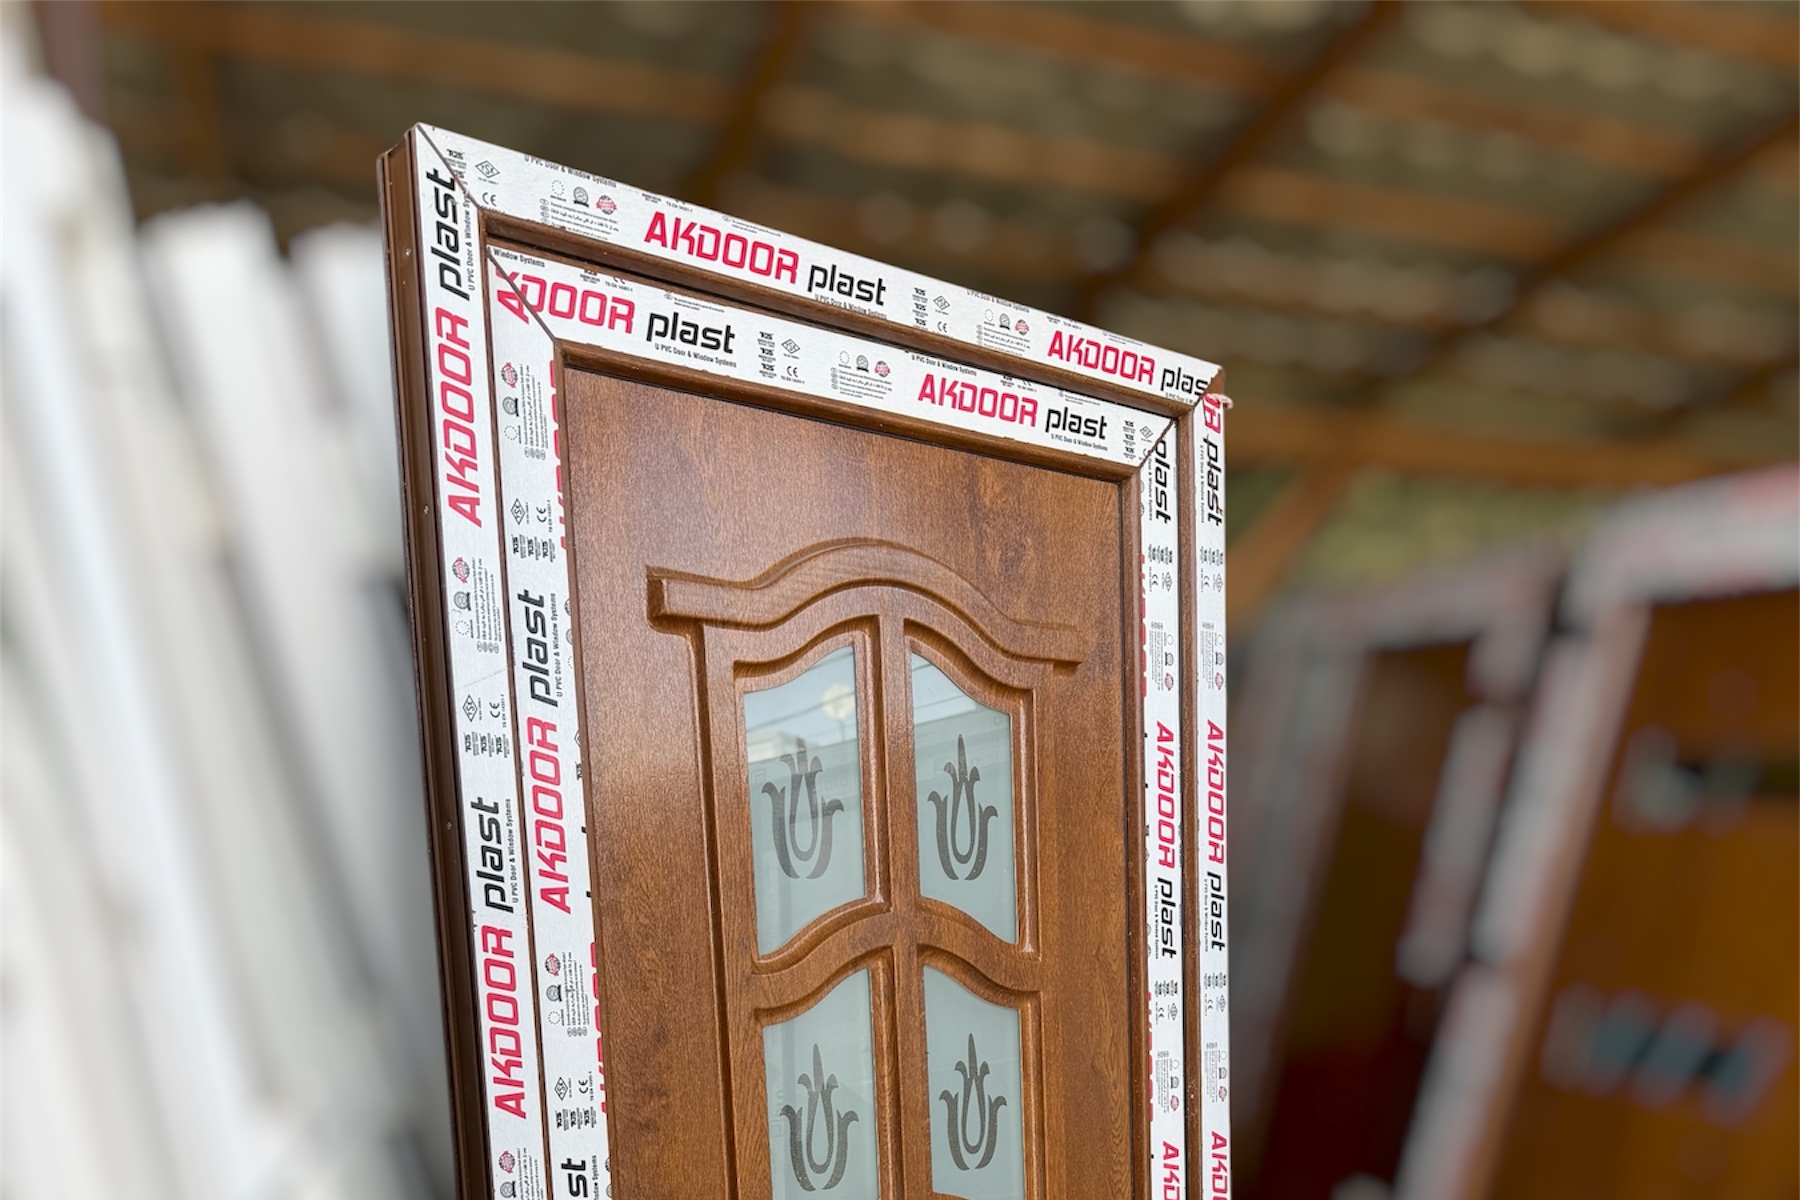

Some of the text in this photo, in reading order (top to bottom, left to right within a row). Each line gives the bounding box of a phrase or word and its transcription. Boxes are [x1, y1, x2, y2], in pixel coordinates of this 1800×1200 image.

[491, 248, 546, 269] Window Systems
[644, 211, 799, 285] AKDOOR
[808, 264, 886, 306] plast
[426, 168, 482, 528] AKDOOR plast
[646, 311, 735, 354] plast
[659, 344, 672, 352] PVC
[671, 346, 686, 356] Door
[691, 351, 714, 362] Window
[713, 356, 737, 369] Systems
[1047, 330, 1155, 386] AKDOOR
[1160, 367, 1208, 396] plas
[917, 373, 1038, 428] AKDOOR
[1045, 406, 1108, 440] plast
[1203, 433, 1223, 527] plast
[549, 592, 558, 621] Systems
[551, 622, 559, 649] Window
[517, 589, 558, 707] plast
[553, 657, 561, 675] Door
[554, 676, 562, 690] PVC
[504, 798, 513, 827] Systems
[506, 828, 514, 855] Window
[527, 716, 572, 914] AKDOOR
[1156, 720, 1176, 958] AKDOOR plast
[1206, 719, 1225, 951] AKDOOR plast
[471, 797, 514, 913] plast
[481, 924, 527, 1120] AKDOOR
[590, 1155, 599, 1180] Systems
